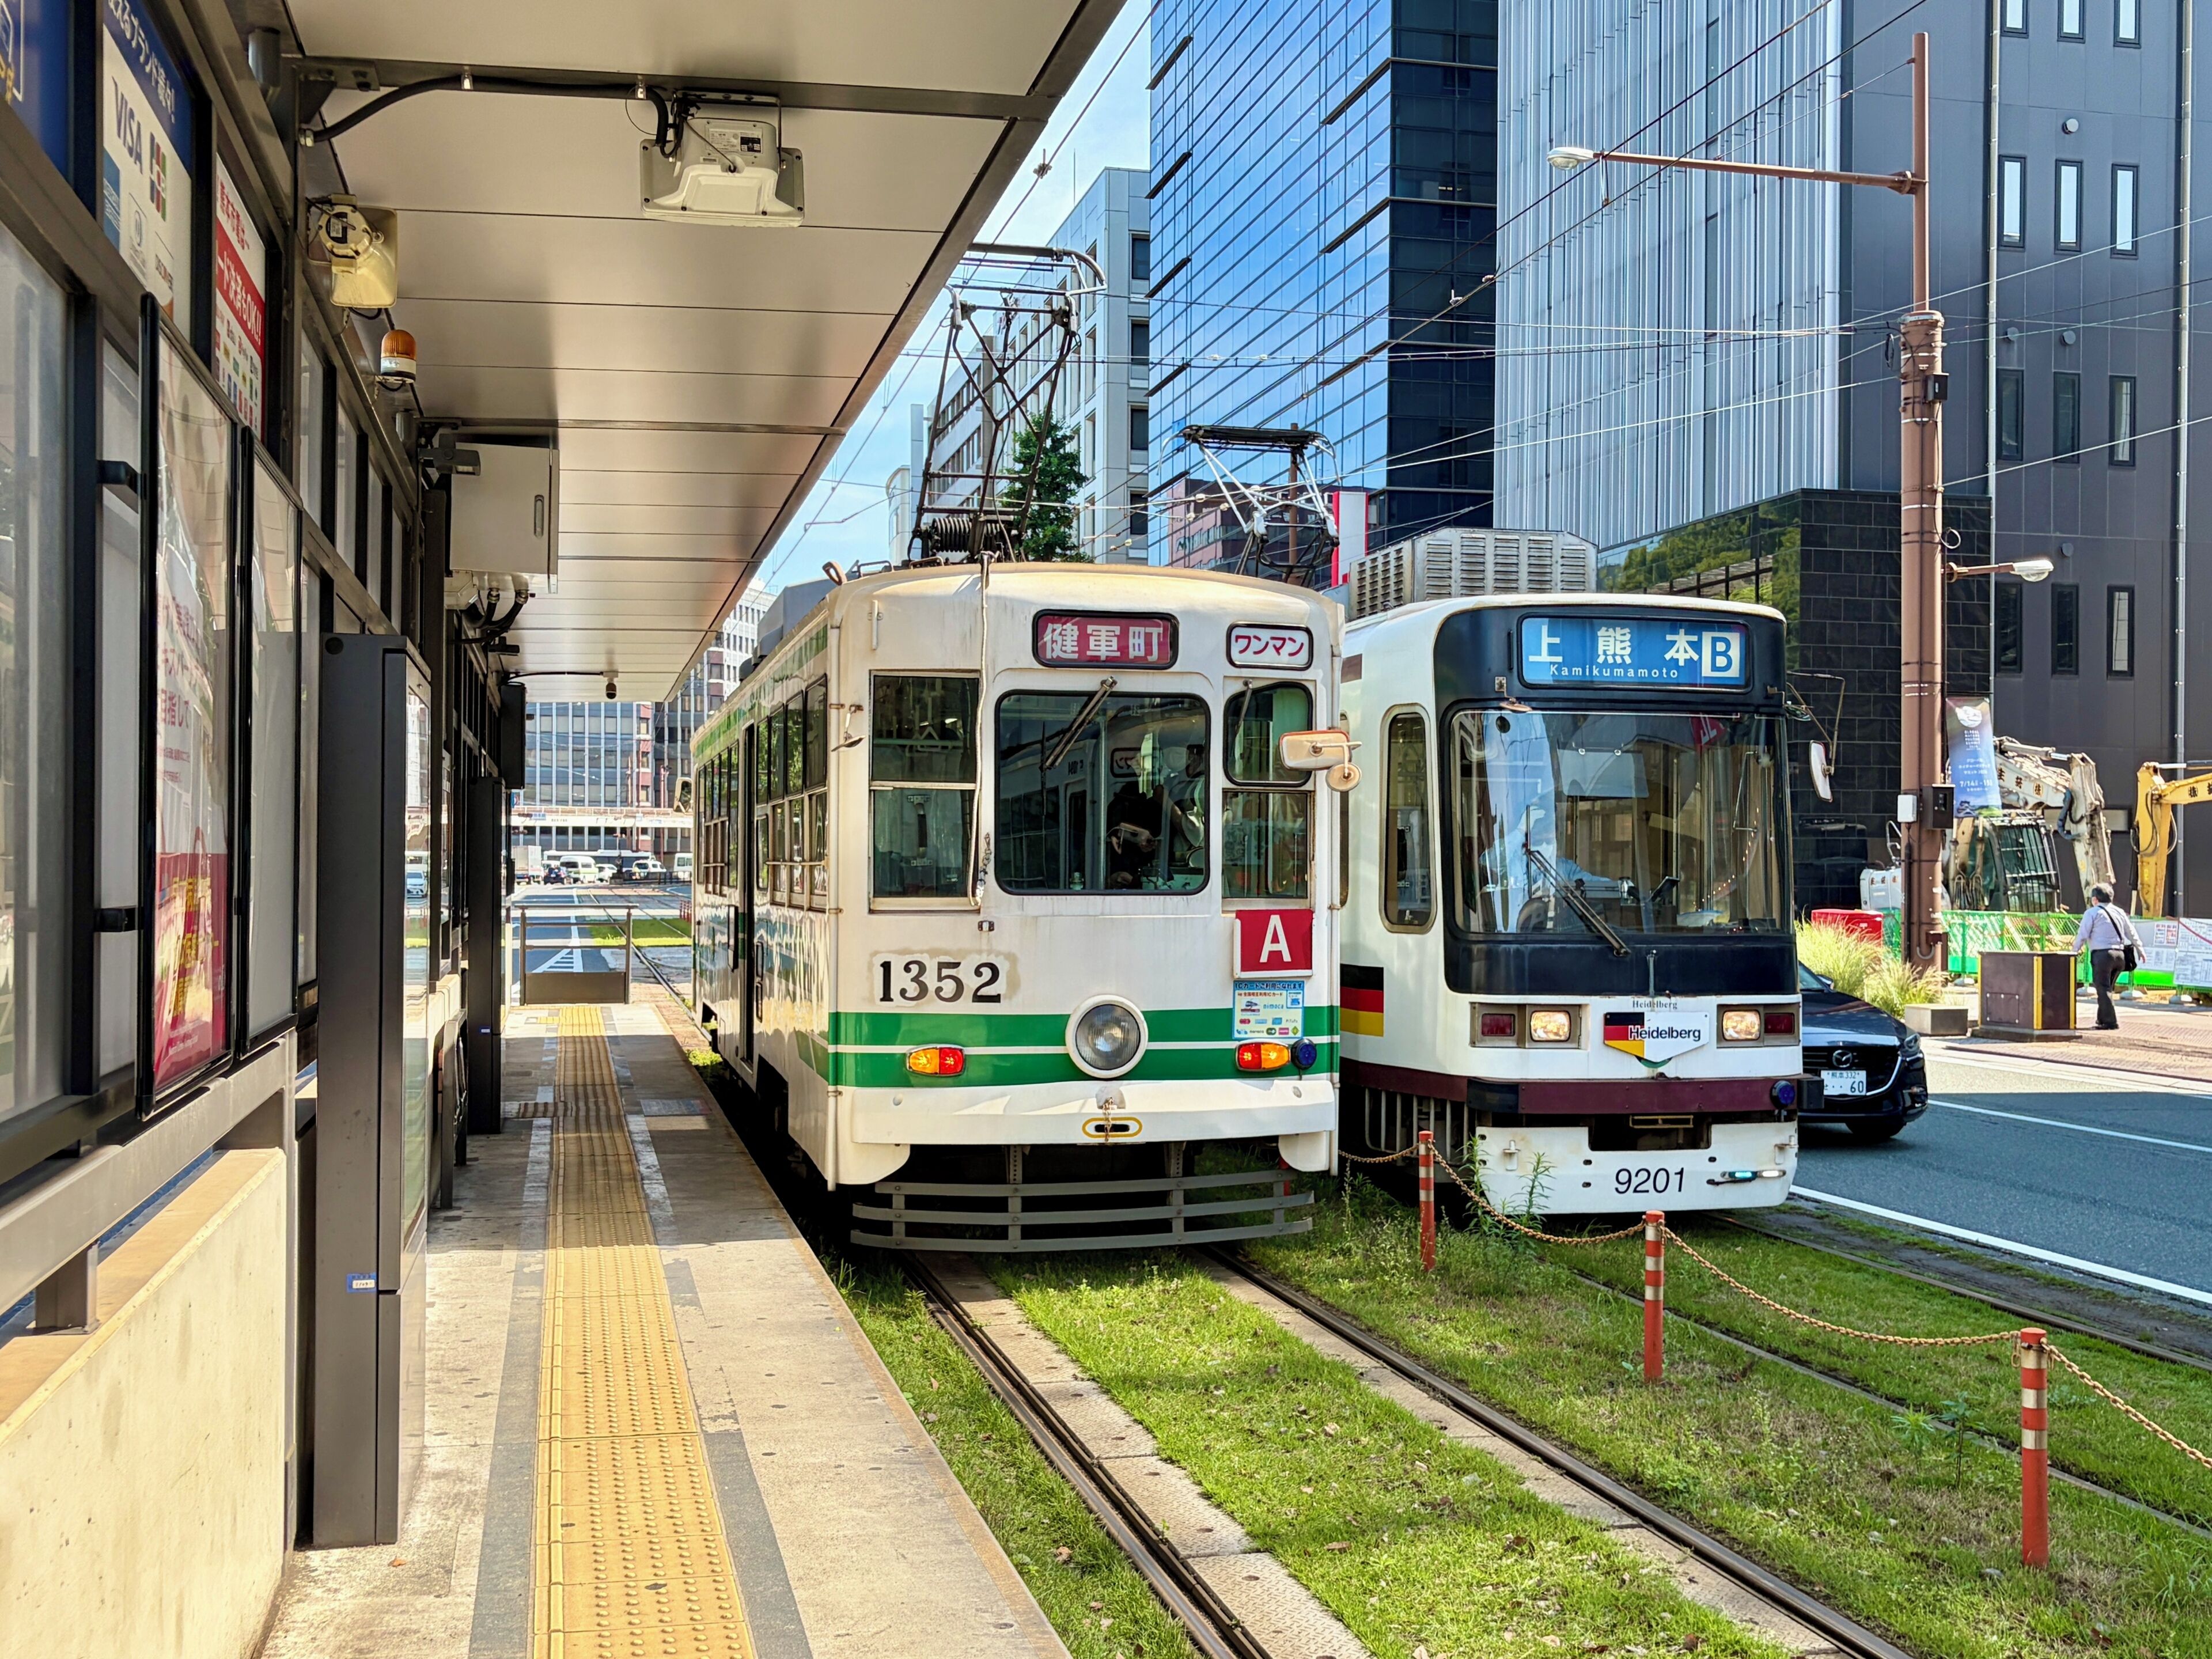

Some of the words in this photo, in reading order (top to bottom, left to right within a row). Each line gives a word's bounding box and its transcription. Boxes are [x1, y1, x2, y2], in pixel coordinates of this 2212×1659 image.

[112, 75, 143, 175] VISA
[216, 240, 262, 346] ード決済もOK!!
[1043, 623, 1163, 662] 健軍町
[1235, 635, 1304, 657] ワンマン
[1528, 624, 1700, 666] 上熊本
[1711, 637, 1733, 673] B
[1550, 664, 1678, 678] Kamikumamoto
[1259, 914, 1291, 963] A
[880, 960, 1001, 1003] 1352
[1632, 1000, 1677, 1009] Heidelberg
[1629, 1026, 1701, 1041] Heidelberg
[1615, 1167, 1684, 1194] 9201
